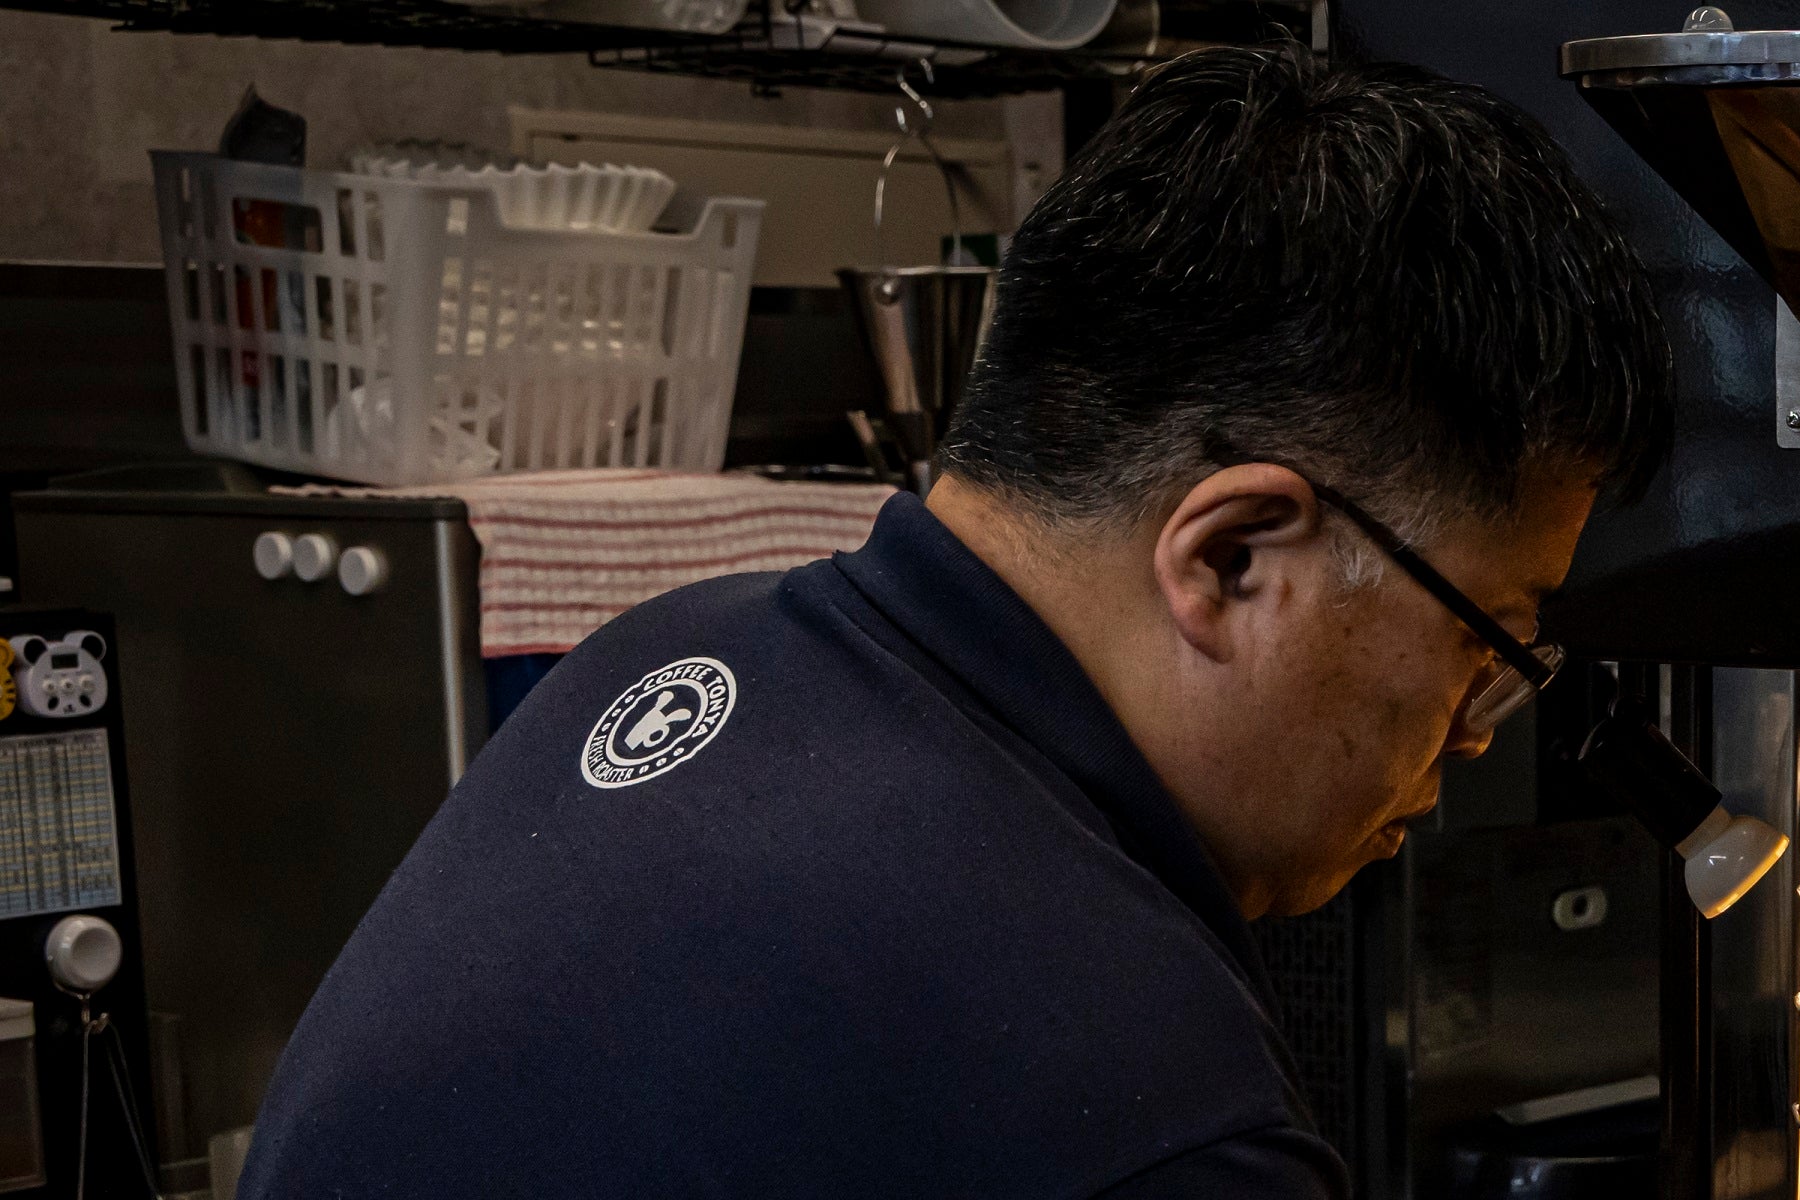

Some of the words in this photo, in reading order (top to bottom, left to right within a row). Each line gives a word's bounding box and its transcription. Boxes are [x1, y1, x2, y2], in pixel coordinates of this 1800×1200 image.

[643, 664, 713, 691] COFFEE
[691, 675, 727, 738] TONYA
[592, 760, 635, 783] ROASTER
